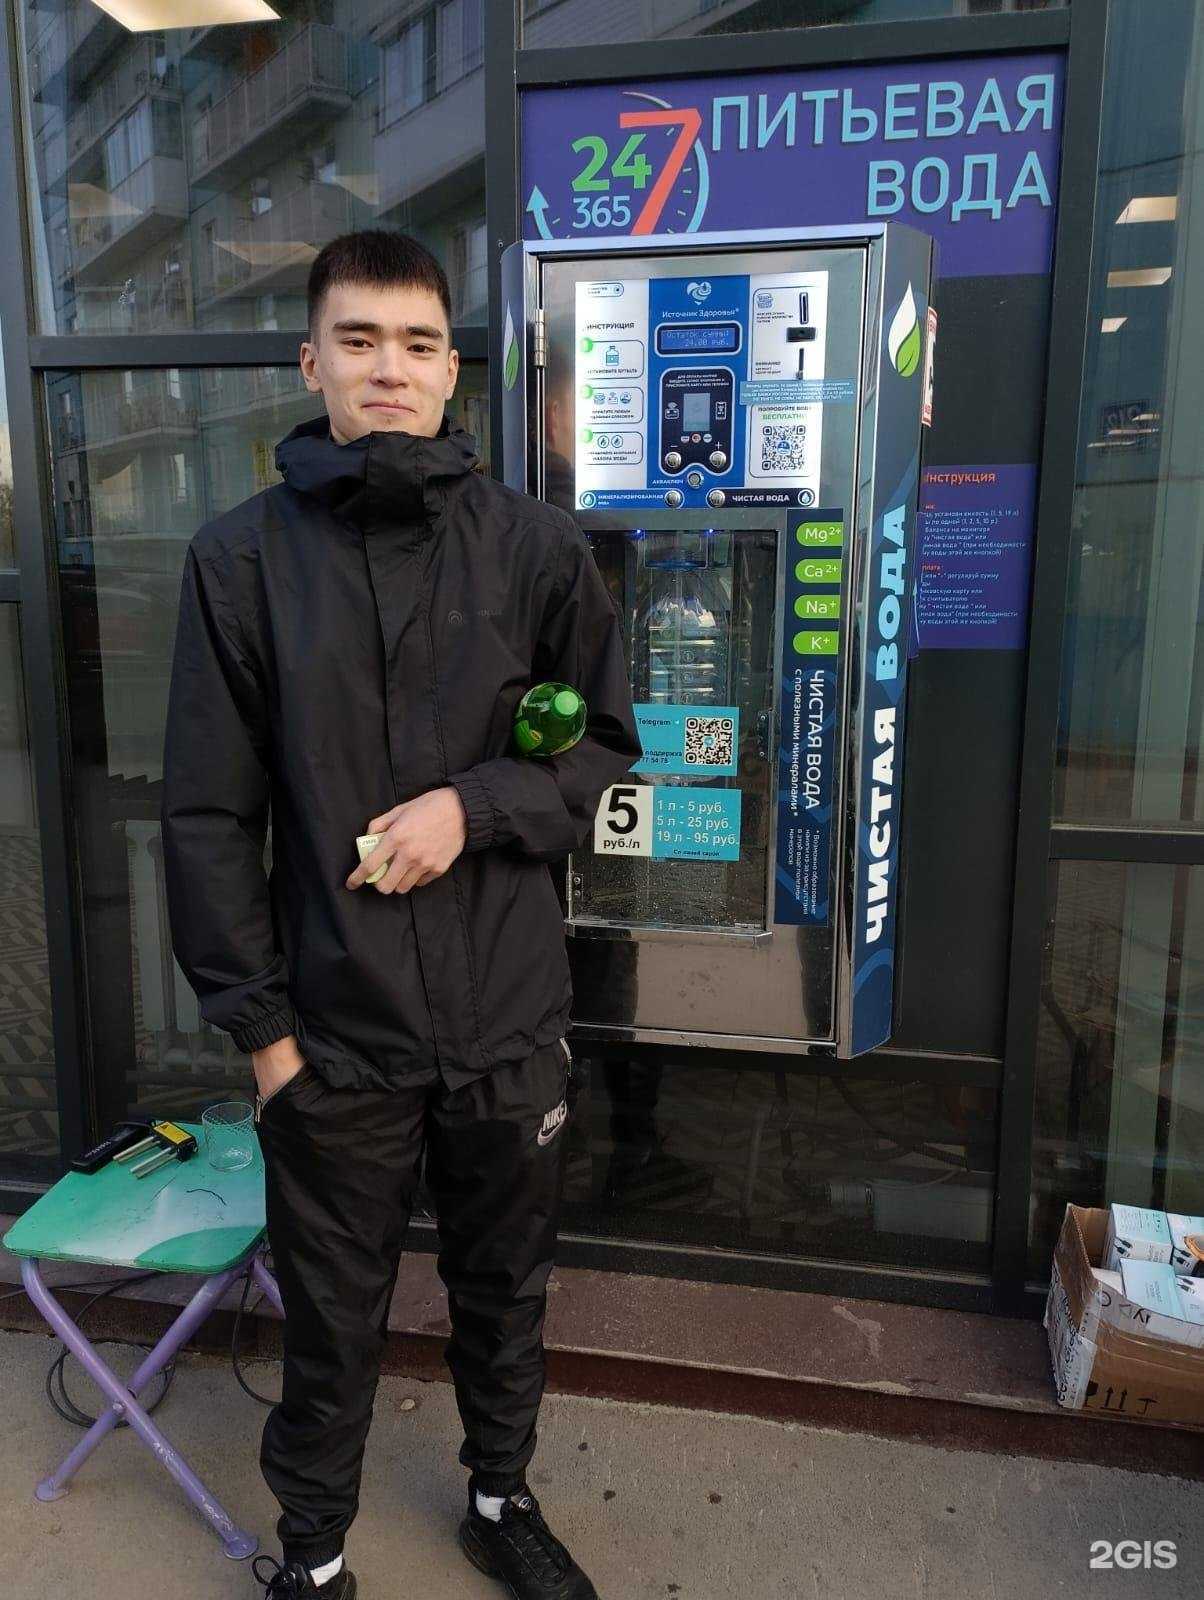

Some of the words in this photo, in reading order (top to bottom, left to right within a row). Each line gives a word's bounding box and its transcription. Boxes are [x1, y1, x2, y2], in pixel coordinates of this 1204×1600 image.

[712, 74, 1056, 152] ПИТЬЕВАЯ
[571, 133, 653, 192] 24
[620, 108, 702, 236] 7
[867, 151, 1052, 222] ВОДА
[572, 194, 631, 229] 365
[766, 494, 791, 502] ВОДА
[876, 504, 906, 681] ВОДА
[638, 717, 671, 726] Telegram
[792, 677, 802, 740] полезными
[807, 669, 825, 748] ЧИСТАЯ
[657, 799, 663, 810] 1
[668, 802, 676, 811] л
[688, 801, 695, 812] 5
[699, 802, 726, 815] руб.
[803, 753, 821, 810] ВОДА
[606, 787, 638, 835] 5
[657, 816, 664, 826] 5
[667, 818, 676, 826] л
[688, 816, 702, 828] 25
[705, 818, 733, 831] руб.
[865, 707, 897, 944] ЧИСТАЯ
[603, 838, 640, 849] руб./л
[656, 830, 671, 842] 19
[674, 834, 682, 842] л
[694, 832, 709, 843] 95
[712, 833, 740, 847] руб.
